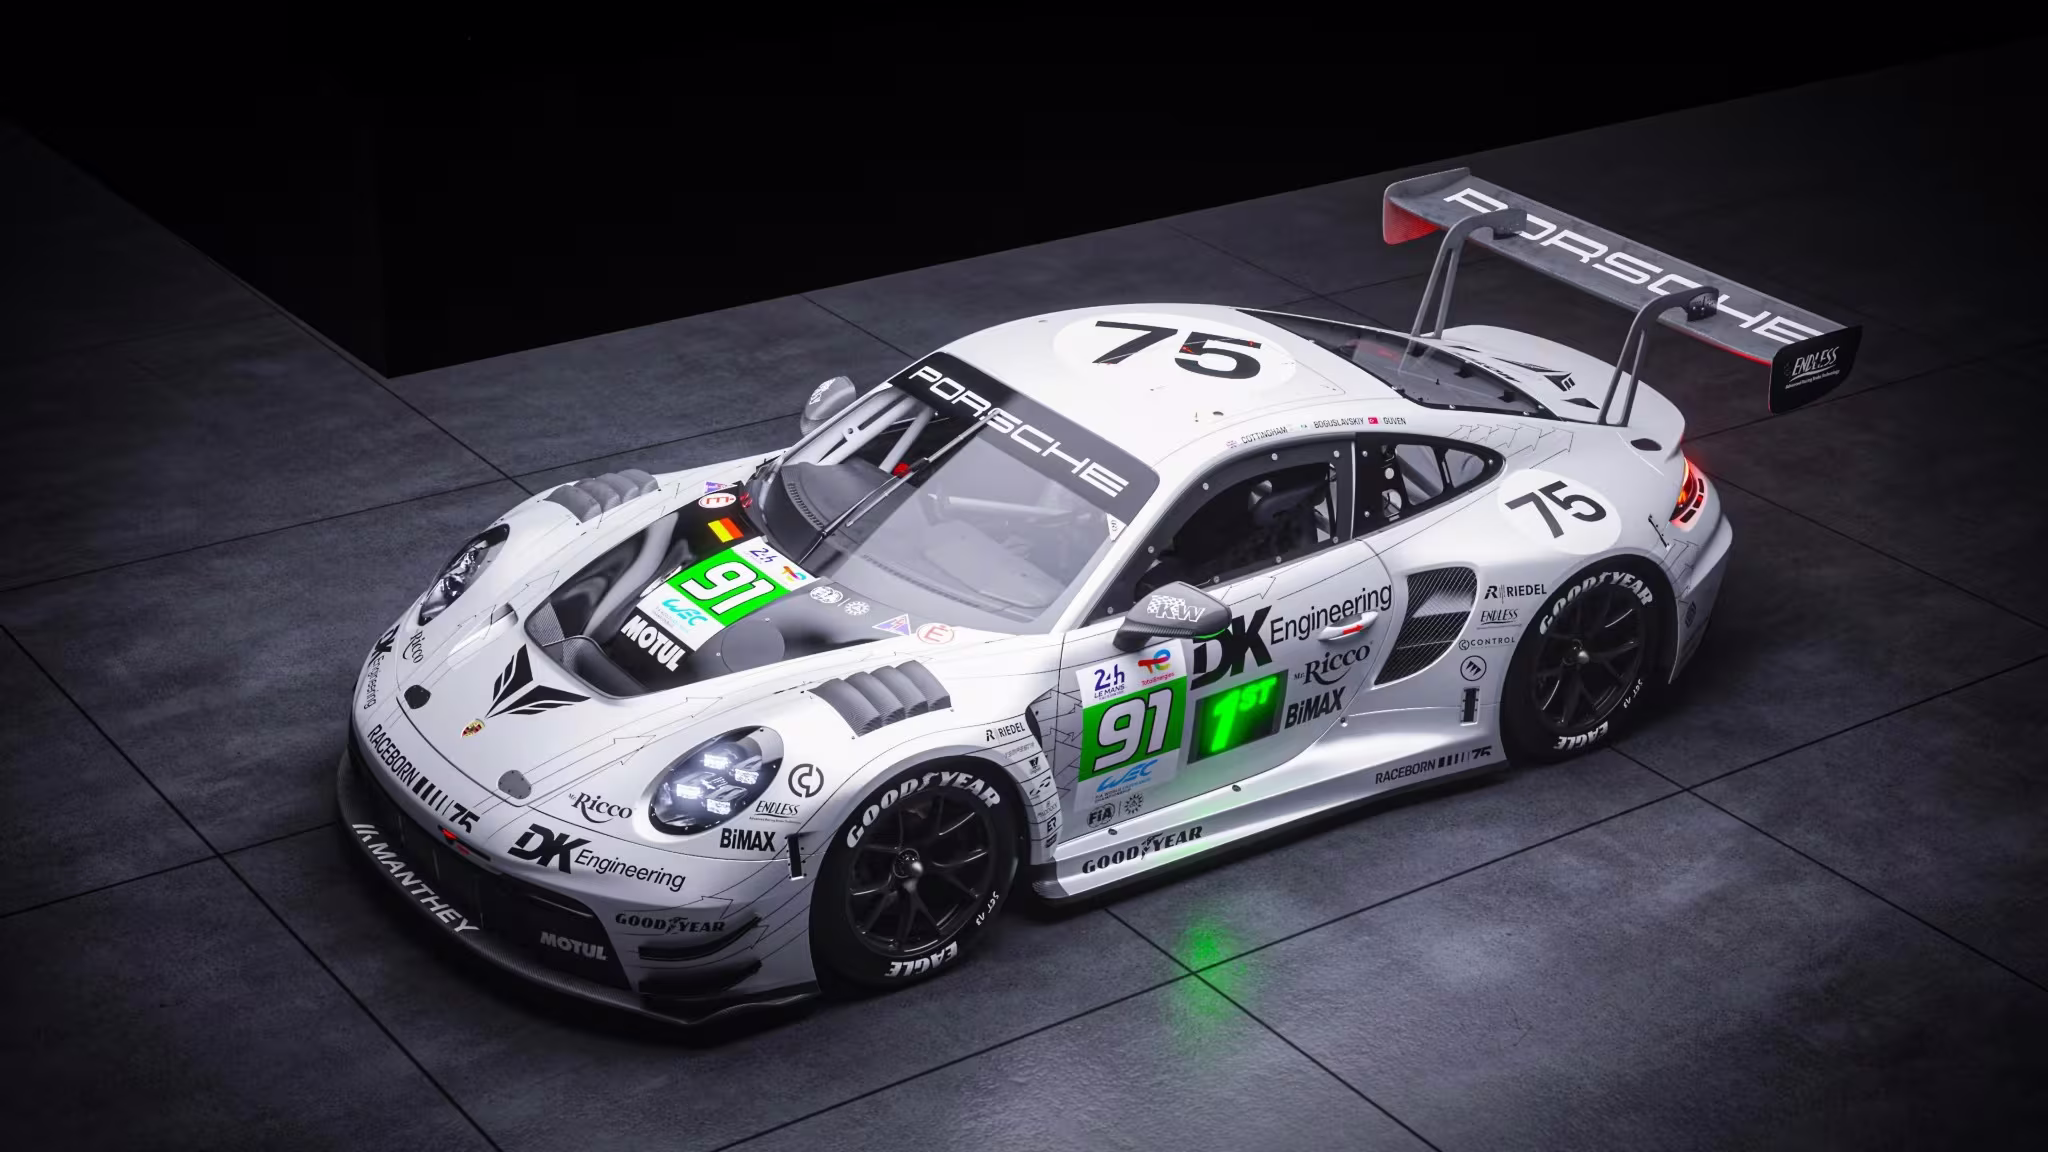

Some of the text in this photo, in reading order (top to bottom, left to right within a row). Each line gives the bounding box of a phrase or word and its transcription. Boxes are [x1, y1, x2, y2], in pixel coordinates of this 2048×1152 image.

[1091, 320, 1262, 379] 75
[908, 365, 1129, 498] PORSCHE
[1504, 480, 1607, 539] 75
[680, 560, 776, 616] 91
[1506, 583, 1547, 598] RIEDEL
[1539, 571, 1653, 636] GOODYEAR
[1155, 603, 1206, 623] KW
[1480, 608, 1518, 623] ENDLESS
[403, 631, 425, 664] Ricco
[620, 614, 686, 672] MOTUL
[1190, 584, 1392, 690] DK Engineering
[1470, 636, 1515, 647] CONTROL
[1302, 644, 1371, 686] Ricco
[1284, 686, 1346, 730] BiMAX
[998, 721, 1026, 738] RIEDEL
[1092, 687, 1174, 773] 91
[1553, 720, 1609, 751] EAGLE
[367, 724, 481, 834] RACEBORN 75
[1375, 745, 1492, 785] RACEBORN 75
[571, 791, 633, 824] Ricco
[755, 800, 801, 817] ENDLESS
[846, 771, 1001, 848] GOODYEAR
[508, 823, 686, 893] DK Engineering
[720, 827, 776, 852] BiMAX
[1082, 825, 1203, 874] GOODYEAR
[369, 840, 480, 933] MANTHEY
[615, 912, 726, 936] GOODYEAR
[540, 931, 608, 961] MOTUL
[885, 940, 958, 978] EAGLE
